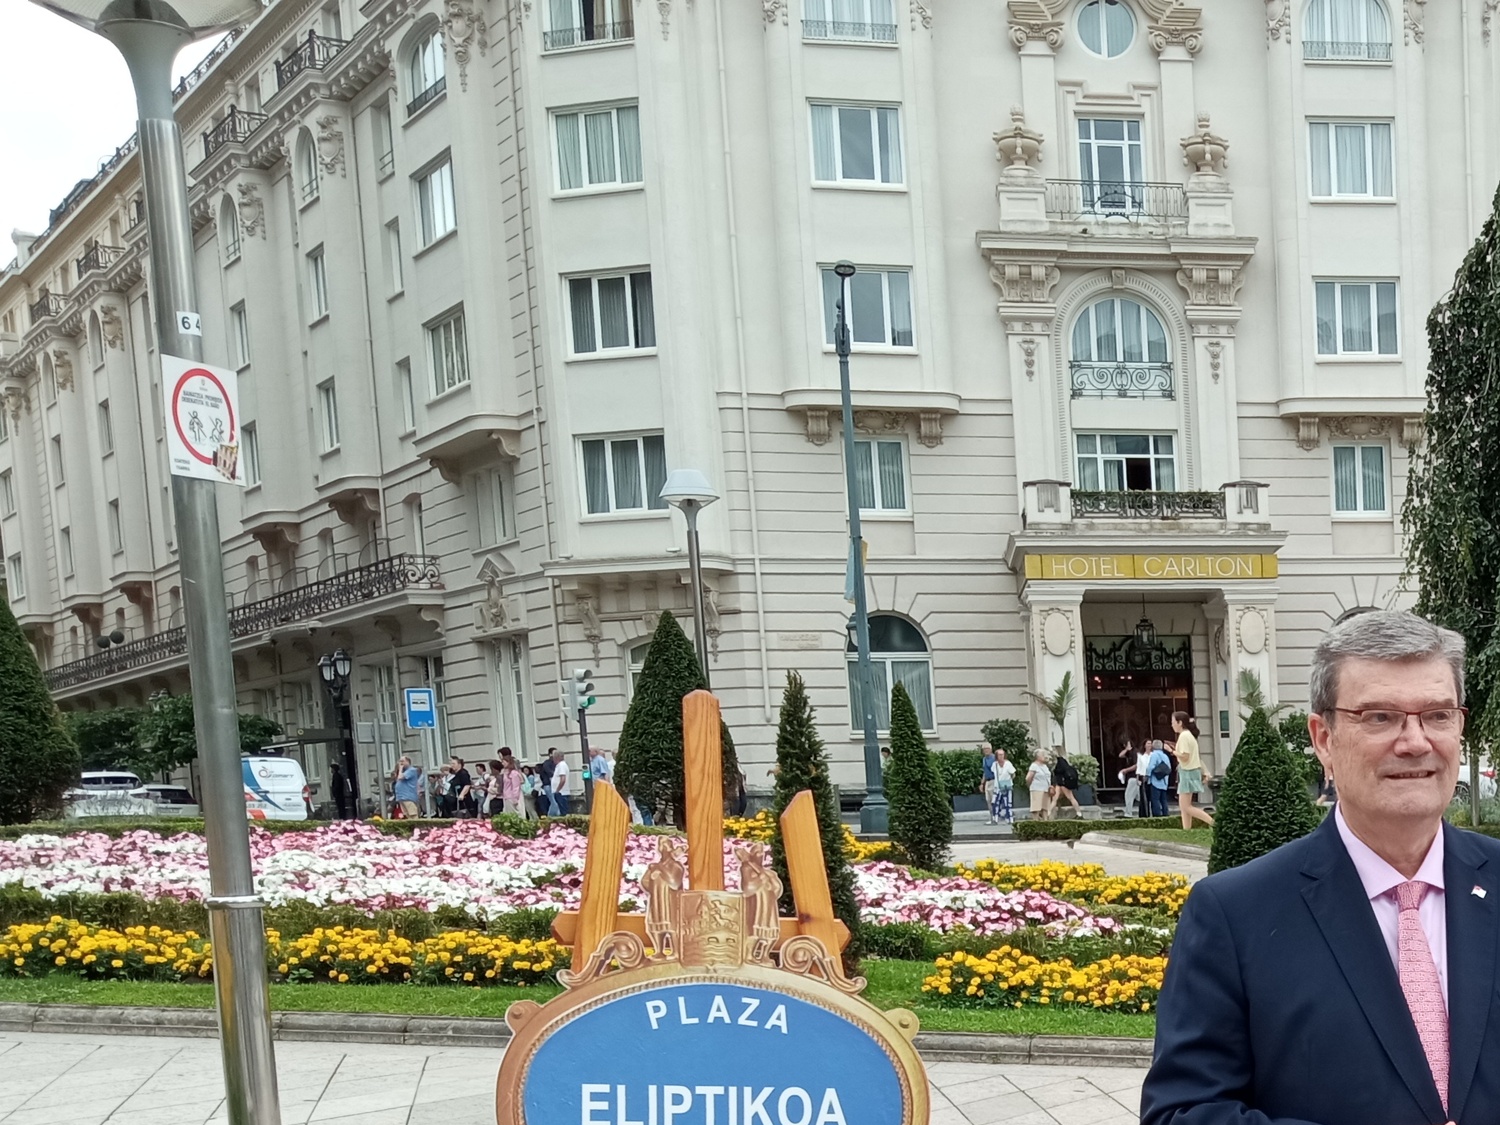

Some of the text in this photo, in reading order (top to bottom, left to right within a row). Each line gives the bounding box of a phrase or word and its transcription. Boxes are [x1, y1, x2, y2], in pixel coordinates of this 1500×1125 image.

[1052, 556, 1253, 577] HOTEL CARLTON
[645, 995, 788, 1034] PLAZA
